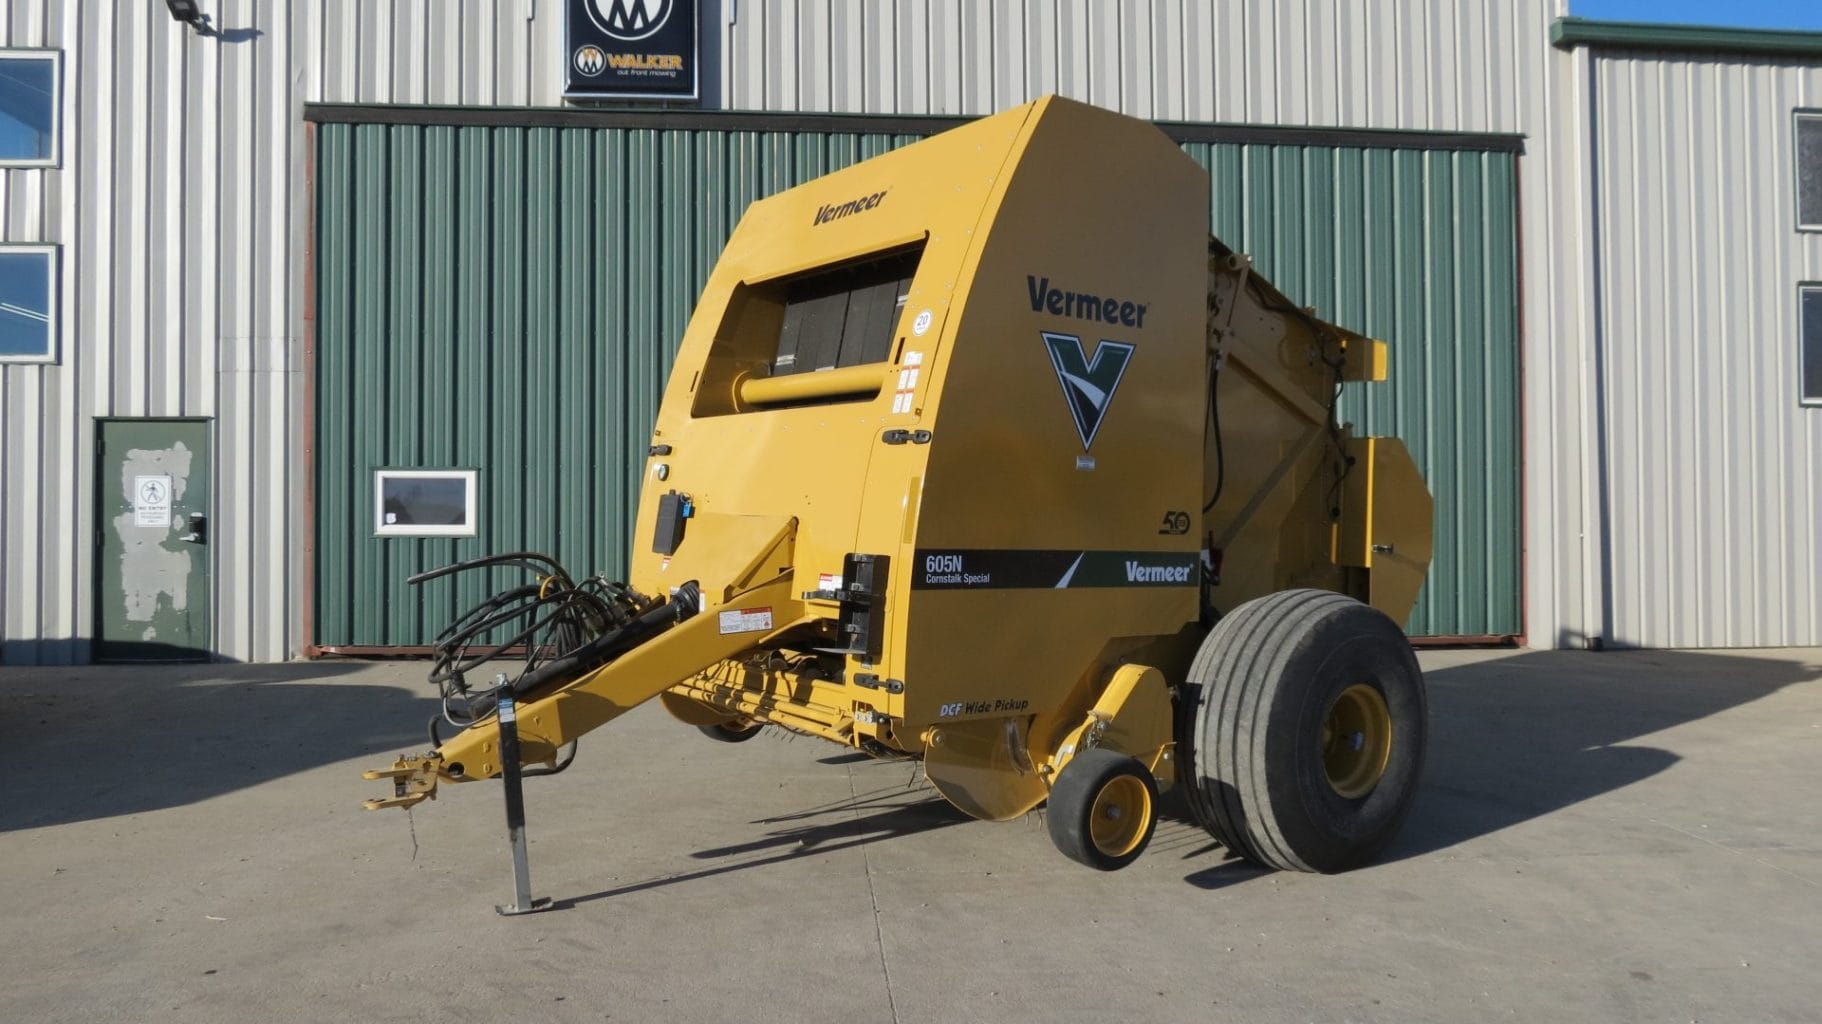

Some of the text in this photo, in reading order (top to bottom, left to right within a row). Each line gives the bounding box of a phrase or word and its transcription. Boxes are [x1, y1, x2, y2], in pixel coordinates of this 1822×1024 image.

[606, 53, 683, 70] WALKER
[649, 70, 677, 78] mowing
[813, 190, 888, 226] Vermeer
[1027, 274, 1147, 329] Vermeer
[926, 555, 962, 573] 605N
[1126, 561, 1190, 582] Vermeer
[926, 574, 990, 585] Cornstalk Special
[940, 700, 1029, 717] DCF Wide Pickup
